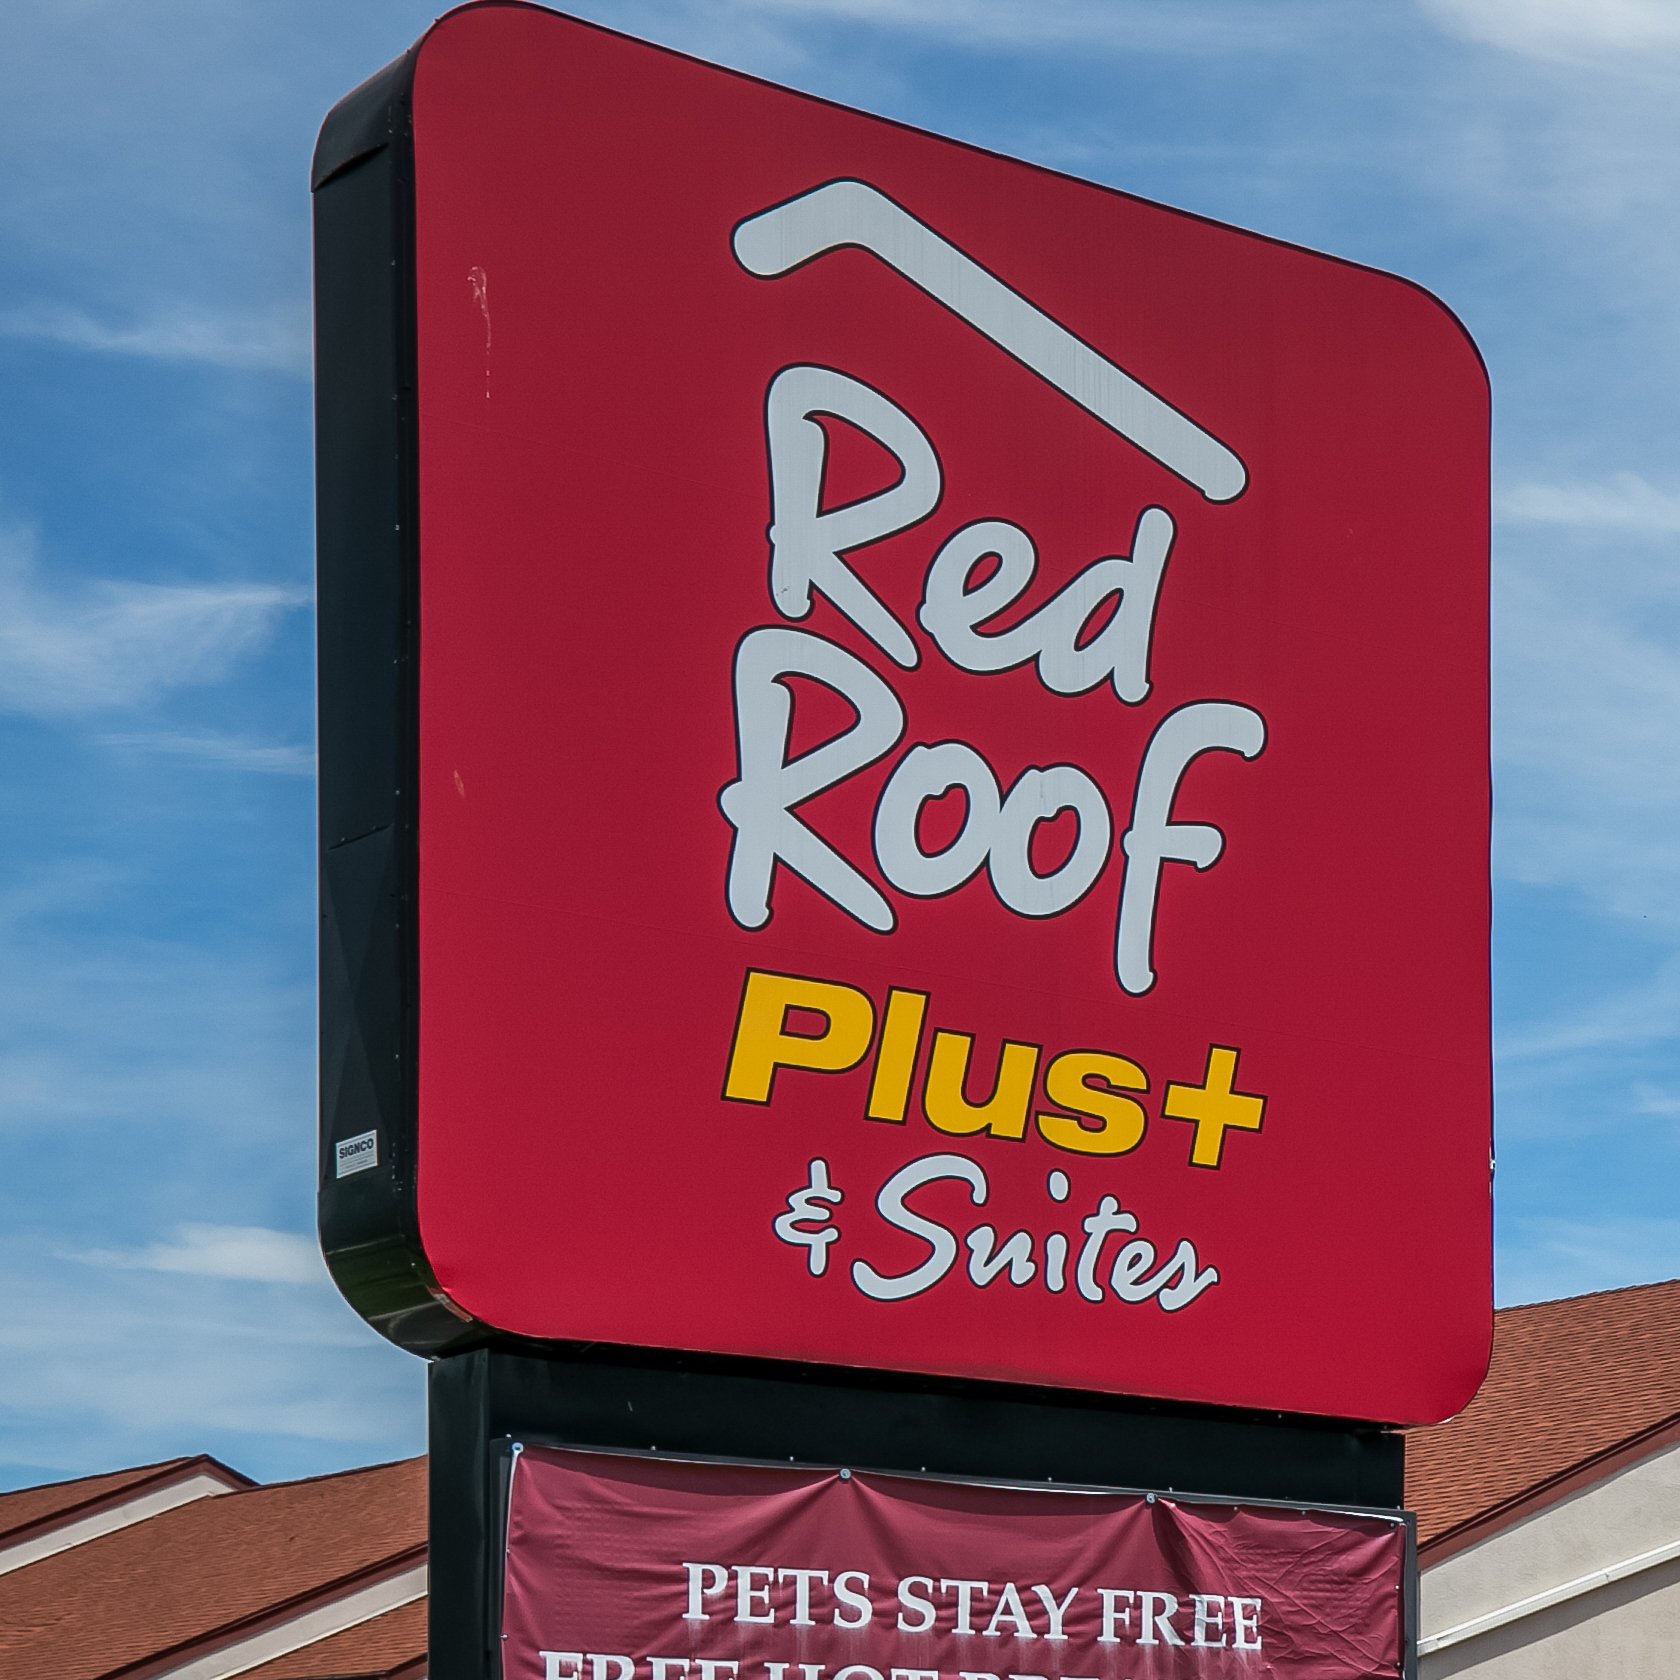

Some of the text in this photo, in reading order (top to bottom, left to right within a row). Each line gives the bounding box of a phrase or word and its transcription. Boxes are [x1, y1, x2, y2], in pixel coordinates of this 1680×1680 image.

[765, 363, 1176, 705] Red
[721, 627, 1268, 996] Roof
[339, 1138, 374, 1159] SIGNCO
[721, 967, 1268, 1170] Plus+
[774, 1153, 1220, 1312] & Suites
[683, 1562, 1262, 1651] PETS STAY FREE
